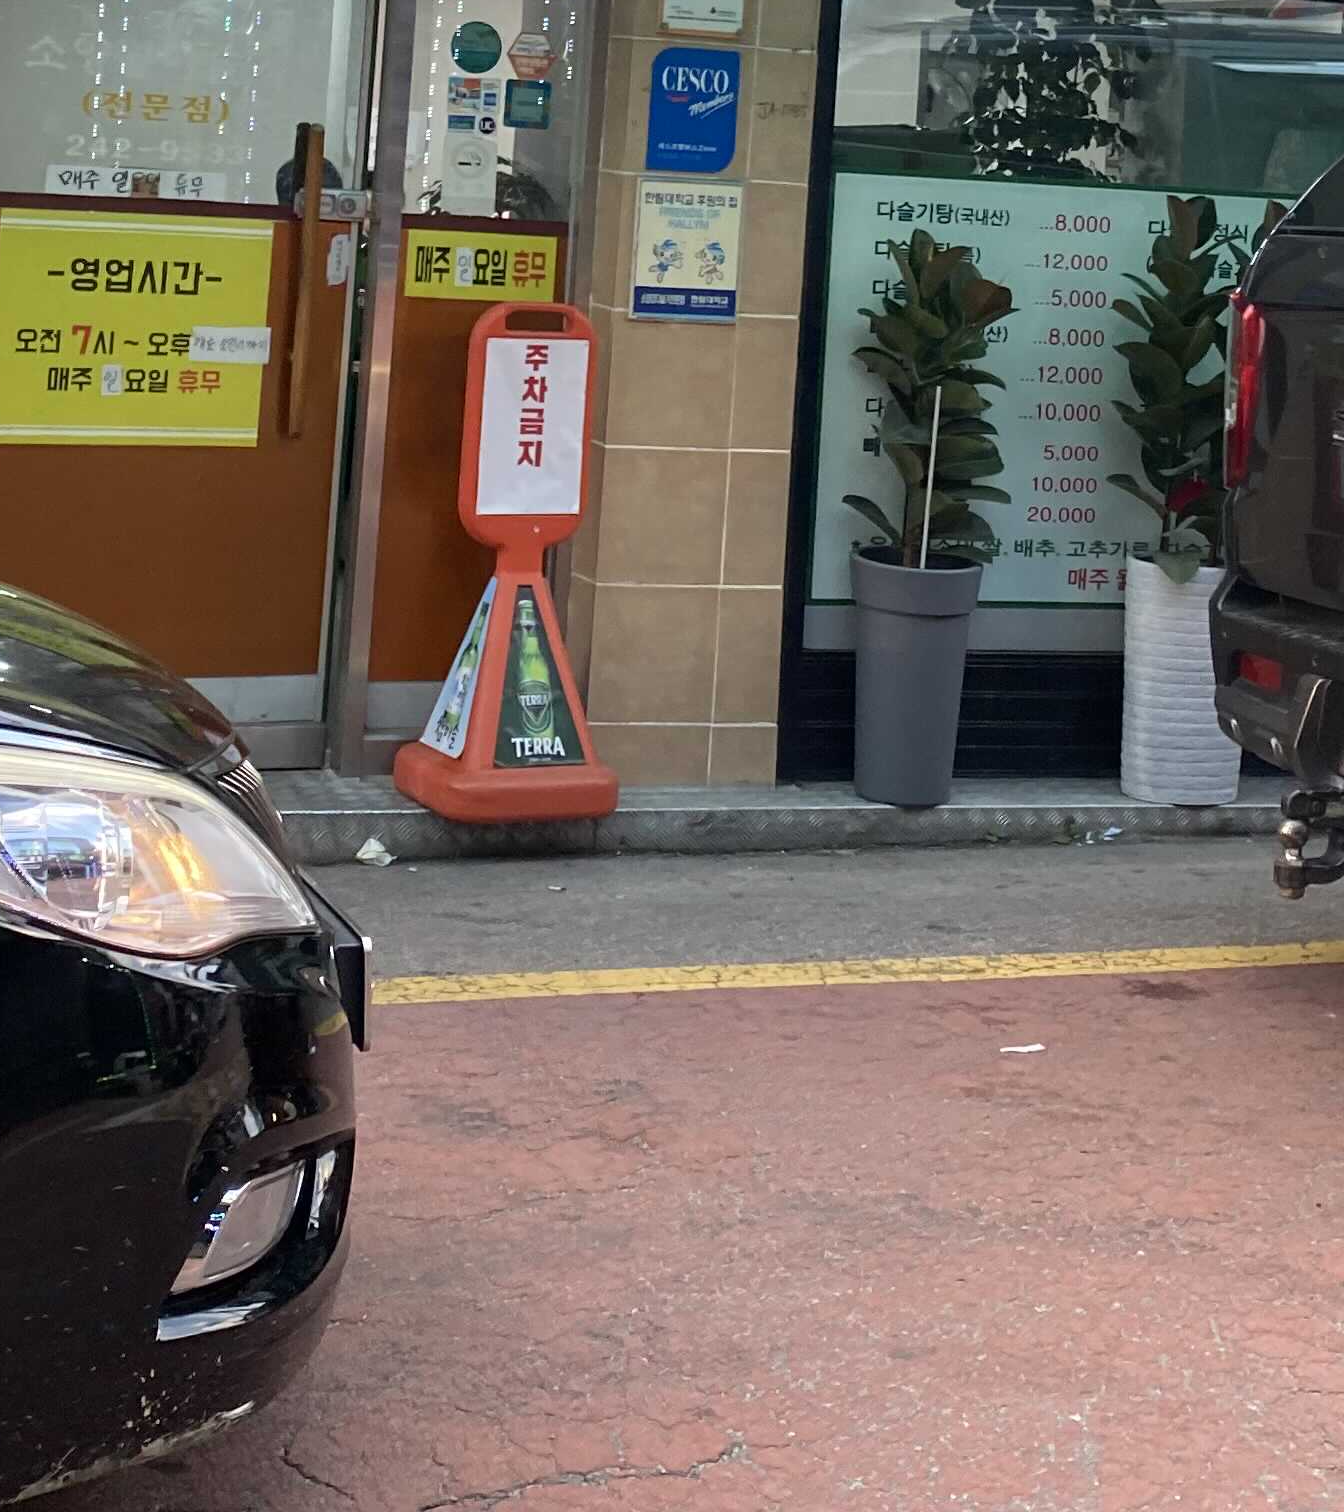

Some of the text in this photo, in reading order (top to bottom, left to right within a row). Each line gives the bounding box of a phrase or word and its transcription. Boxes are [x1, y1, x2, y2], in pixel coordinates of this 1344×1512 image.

[662, 65, 729, 95] CESCO
[415, 245, 451, 284] 매주
[512, 249, 547, 288] 휴무
[15, 328, 61, 354] 오전
[71, 324, 115, 355] 7시
[147, 332, 191, 357] 오후
[47, 367, 93, 392] 매주
[177, 369, 221, 394] 휴무
[517, 345, 549, 468] 주차금지
[1068, 568, 1110, 590] 매주
[511, 736, 565, 758] TERRA
